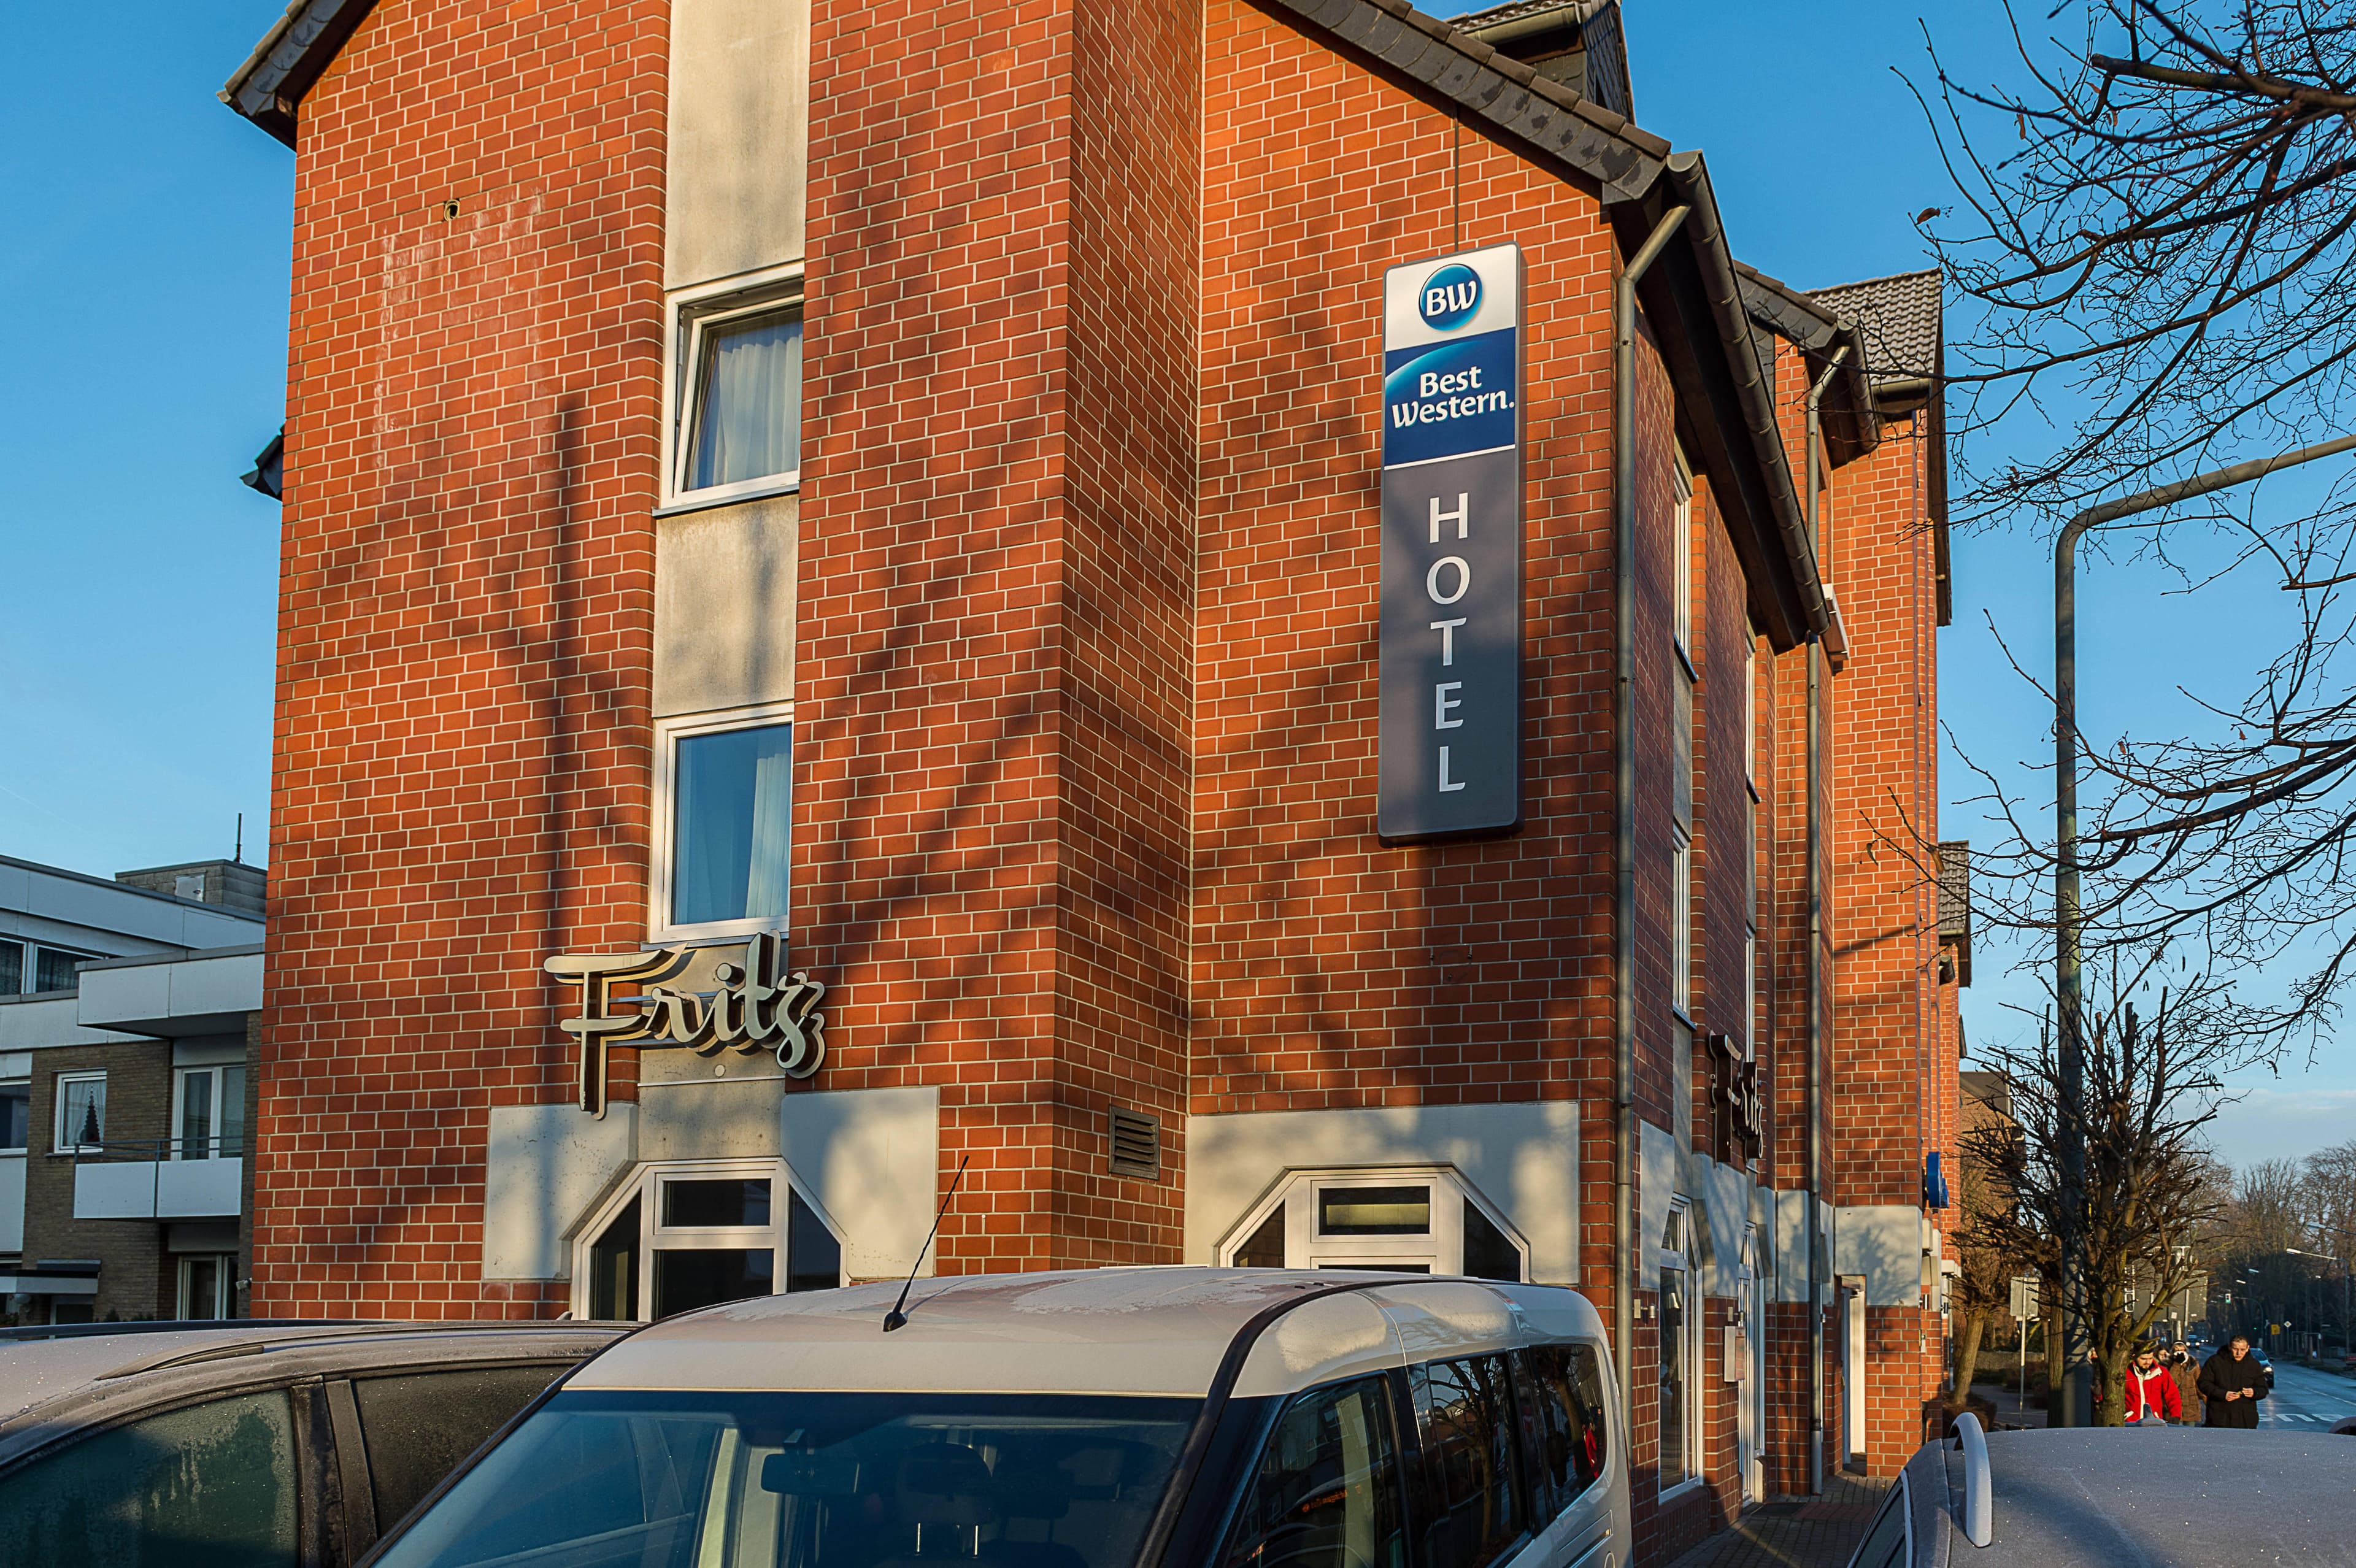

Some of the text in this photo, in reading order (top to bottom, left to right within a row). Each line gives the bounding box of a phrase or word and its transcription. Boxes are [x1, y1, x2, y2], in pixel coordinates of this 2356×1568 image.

[1426, 280, 1477, 317] BW
[1420, 366, 1482, 398] Best
[1426, 492, 1471, 792] HOTEL
[544, 929, 825, 1120] Fritz
